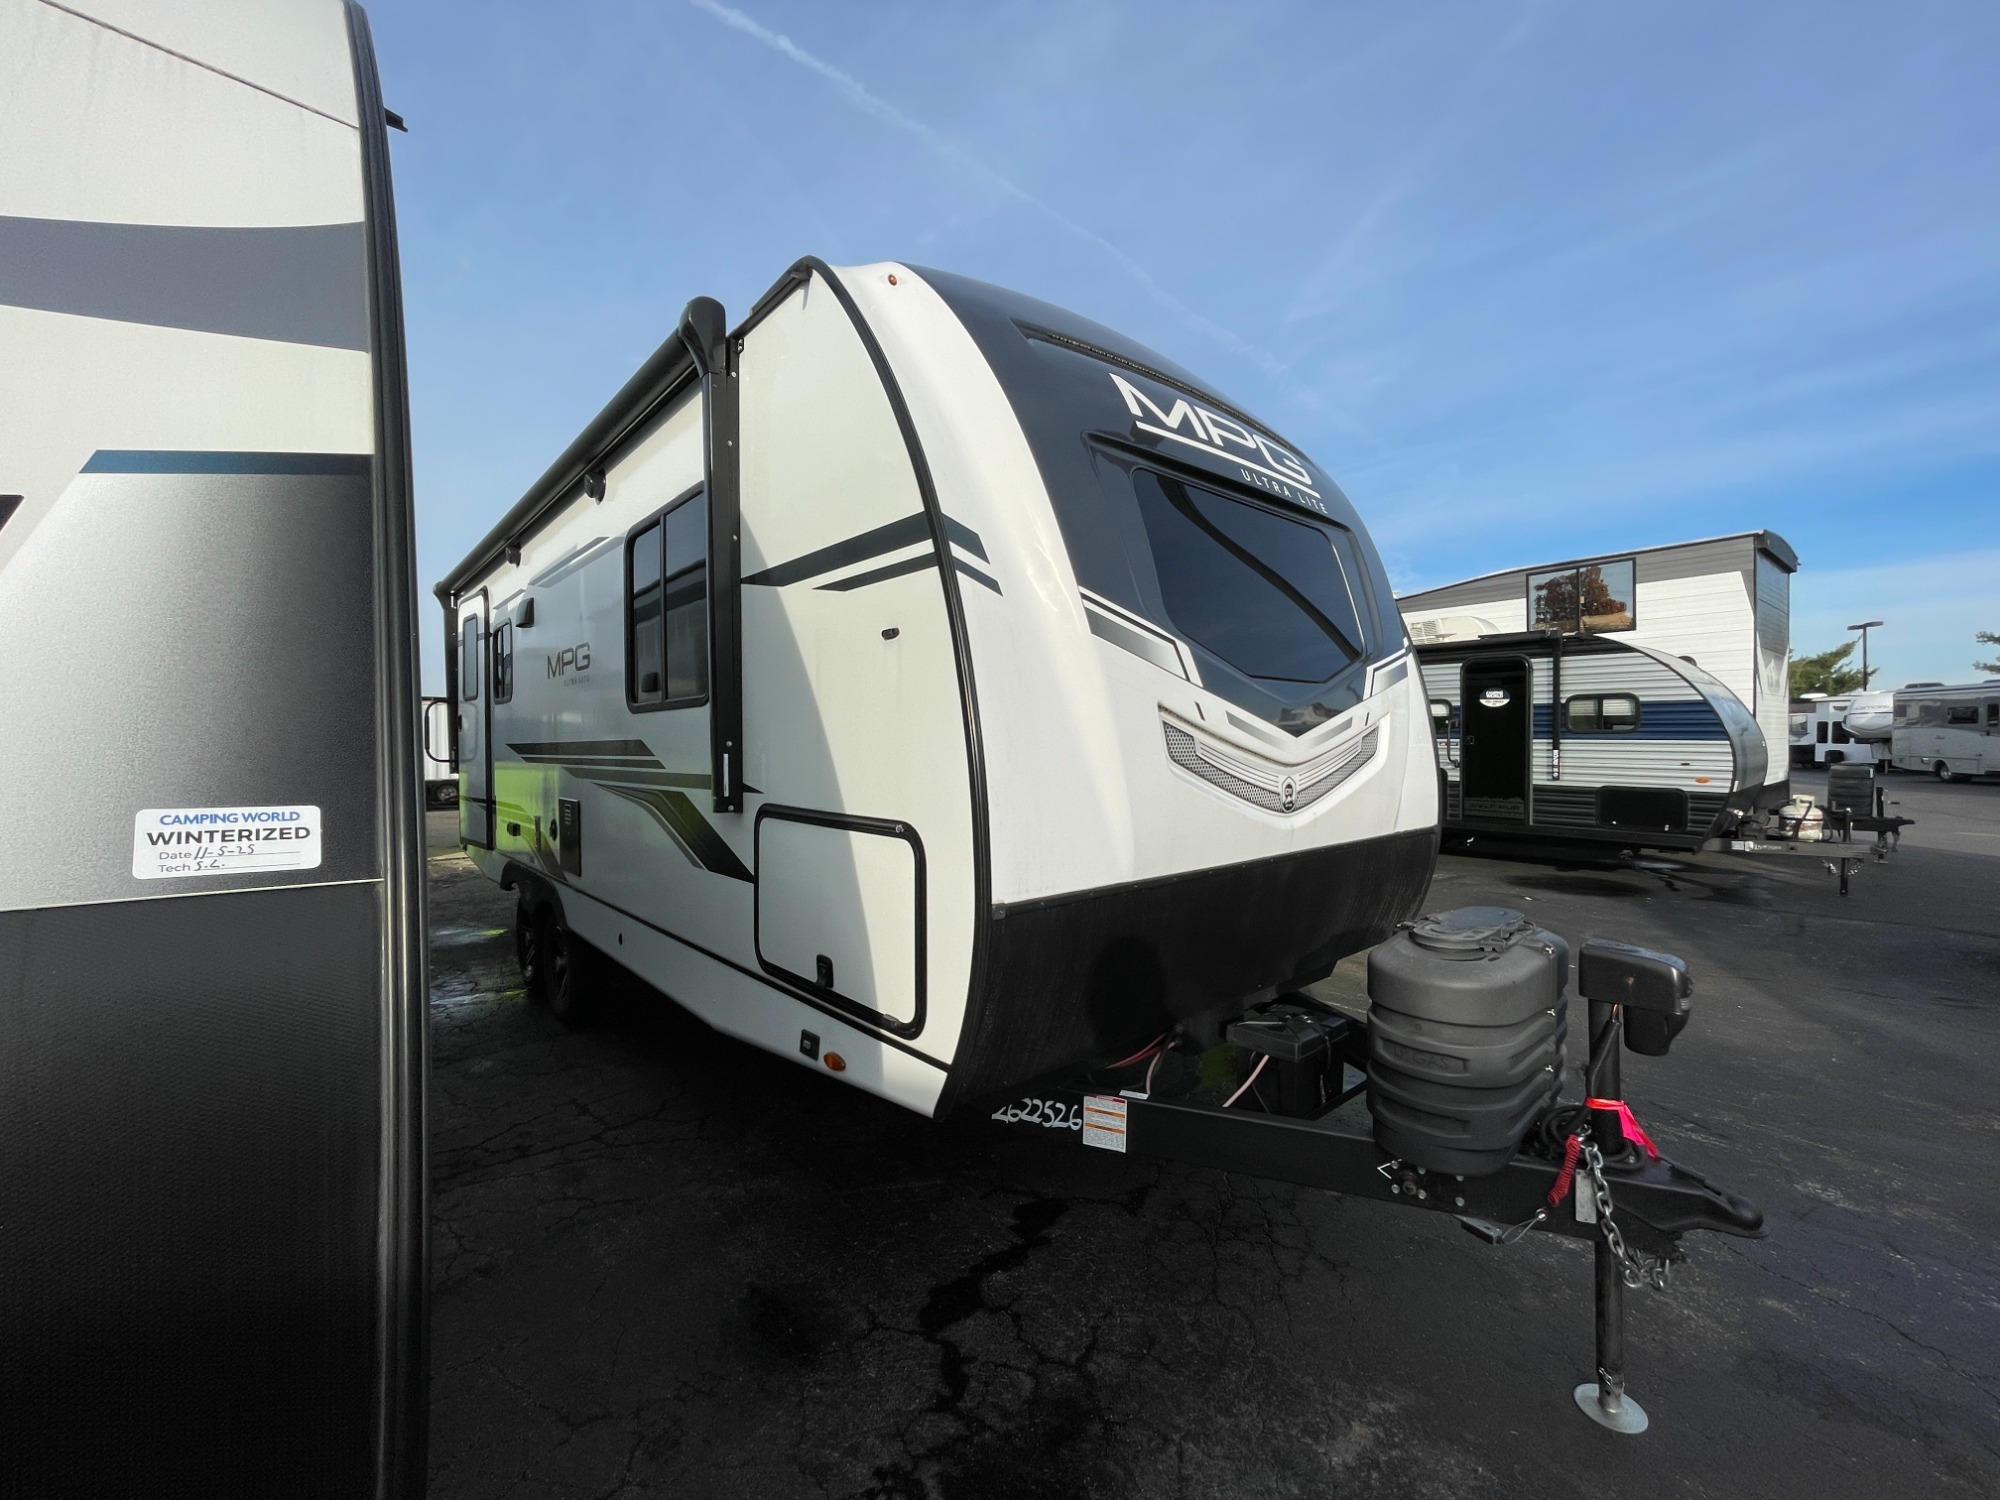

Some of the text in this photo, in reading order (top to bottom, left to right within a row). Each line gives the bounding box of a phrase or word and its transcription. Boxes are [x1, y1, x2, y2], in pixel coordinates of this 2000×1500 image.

[1109, 372, 1312, 485] MPG
[1241, 469, 1328, 514] ULTRA LITE
[547, 642, 590, 679] MPG
[159, 811, 300, 826] CAMPING WORLD
[147, 826, 311, 846] WINTERIZED
[159, 851, 192, 860] Date
[158, 863, 191, 872] Tech
[1413, 1052, 1451, 1070] GAS
